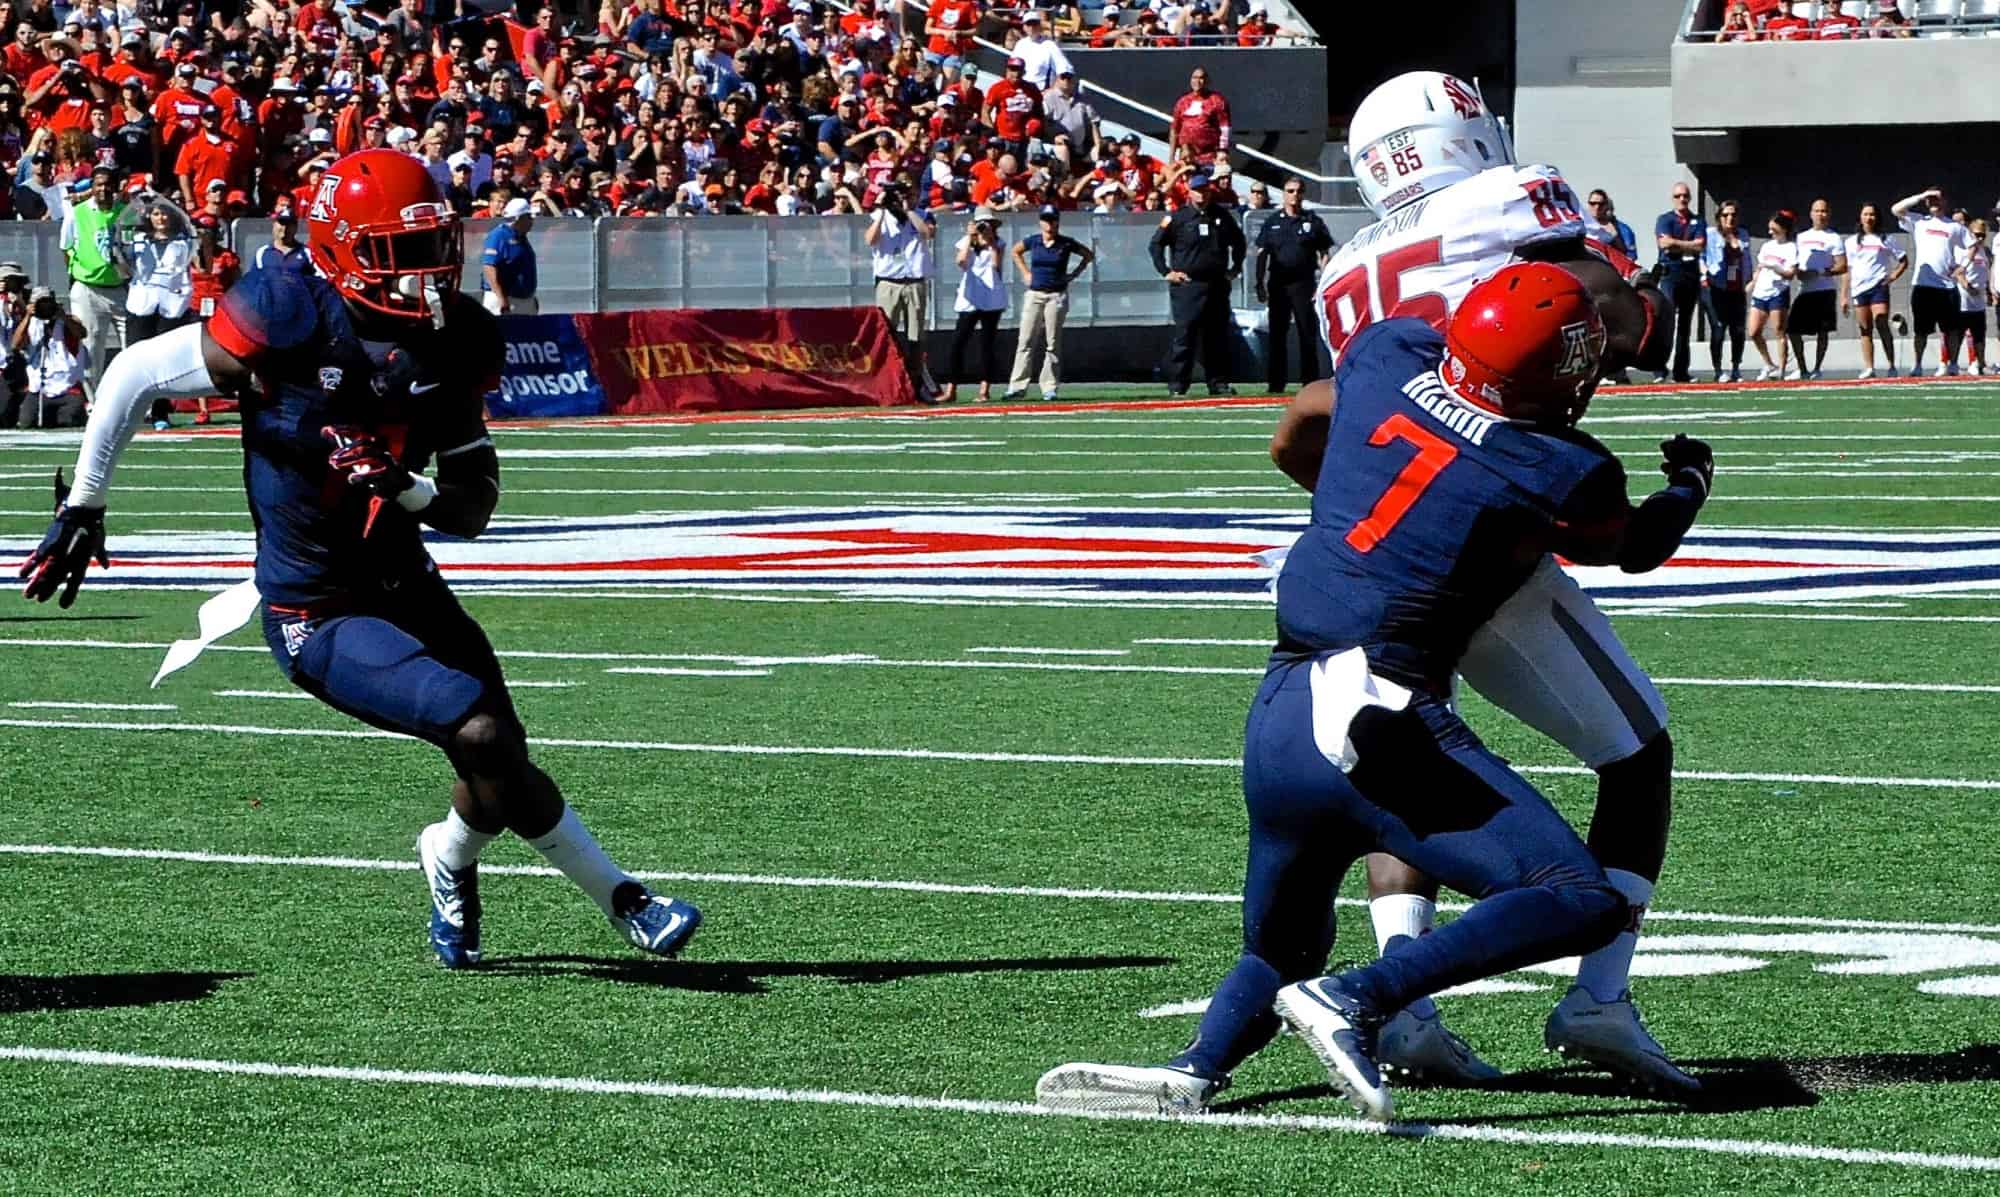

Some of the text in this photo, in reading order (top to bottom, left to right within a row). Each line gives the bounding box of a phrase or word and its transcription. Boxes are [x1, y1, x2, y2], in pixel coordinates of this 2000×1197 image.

[1387, 131, 1410, 150] ESF
[1391, 147, 1423, 176] 85
[310, 175, 342, 222] A
[1519, 176, 1581, 228] 85
[504, 341, 561, 364] ame
[614, 341, 874, 381] WELLS FARGO
[490, 370, 589, 402] ponsor
[1344, 412, 1459, 553] 7
